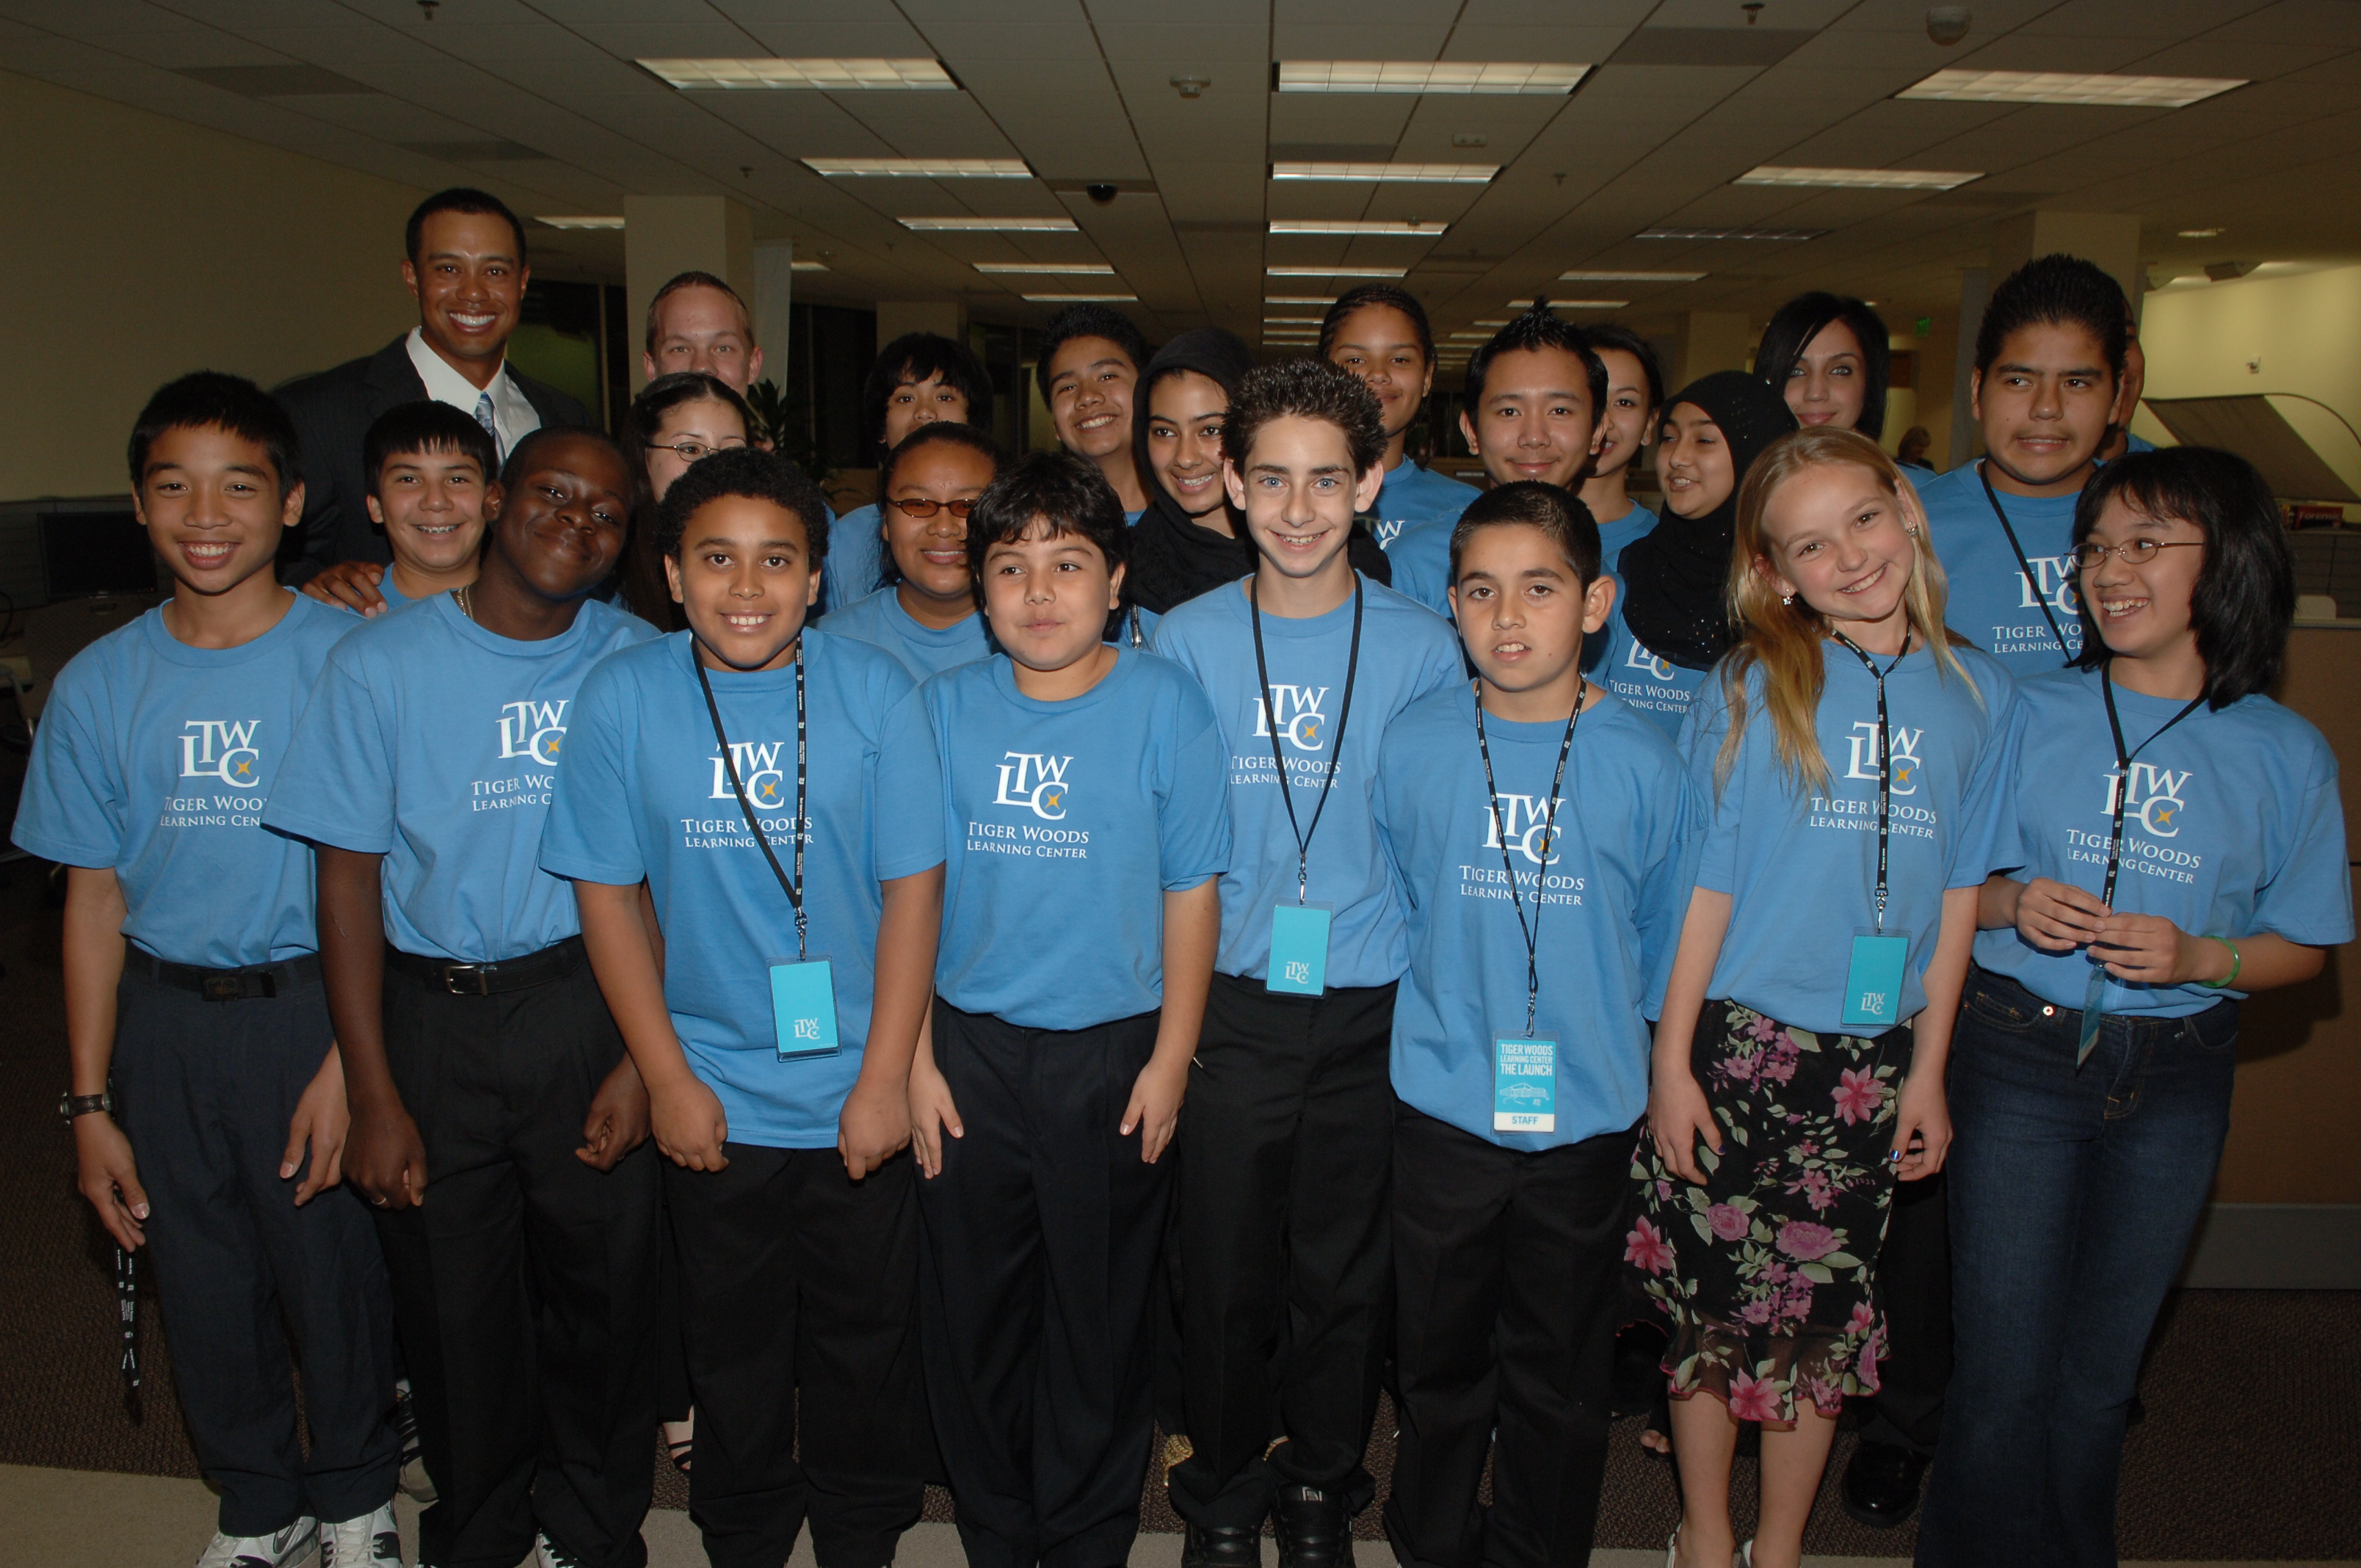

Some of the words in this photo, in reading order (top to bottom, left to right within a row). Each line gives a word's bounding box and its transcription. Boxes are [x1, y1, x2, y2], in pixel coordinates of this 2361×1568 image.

[1992, 625, 2046, 639] TIGER
[1994, 641, 2062, 653] LEARNING
[1609, 679, 1643, 696] TIGER
[1645, 684, 1690, 701] WOODS
[1655, 701, 1689, 714] CENTER
[1231, 756, 1278, 770] TIGER
[1282, 756, 1342, 774] WOODS
[471, 778, 521, 796] TIGER
[1294, 776, 1338, 788] CENTR
[164, 797, 208, 811] TIGER
[214, 796, 267, 811] WOO
[472, 794, 537, 812] LEARNING
[1811, 797, 1868, 815] TIGER
[160, 815, 226, 827] LEARNING
[681, 819, 738, 833] TIGER
[1810, 816, 1878, 831] LEARNING
[968, 821, 1017, 839] TIGER
[1022, 825, 1089, 843] WOODS
[685, 837, 755, 849] LEARNING
[764, 834, 813, 846] ENTR
[967, 839, 1031, 856] LEARNING
[1036, 846, 1087, 859] CENTER
[2128, 838, 2202, 868] WOODS
[2067, 848, 2136, 870] LEARNNG
[2138, 860, 2194, 884] CENTER
[1459, 865, 1509, 884] TIGER
[1515, 870, 1584, 890] WOODS
[1460, 884, 1523, 901] LEARNING
[1528, 891, 1583, 905] CENTER
[1501, 1044, 1523, 1055] TIGER
[1524, 1045, 1553, 1056] WOODS
[1500, 1055, 1529, 1064] LEARNING
[1530, 1056, 1553, 1064] CENTER
[1501, 1064, 1517, 1075] THE
[1517, 1064, 1553, 1076] LAUNCH
[1512, 1115, 1539, 1125] STAFF
